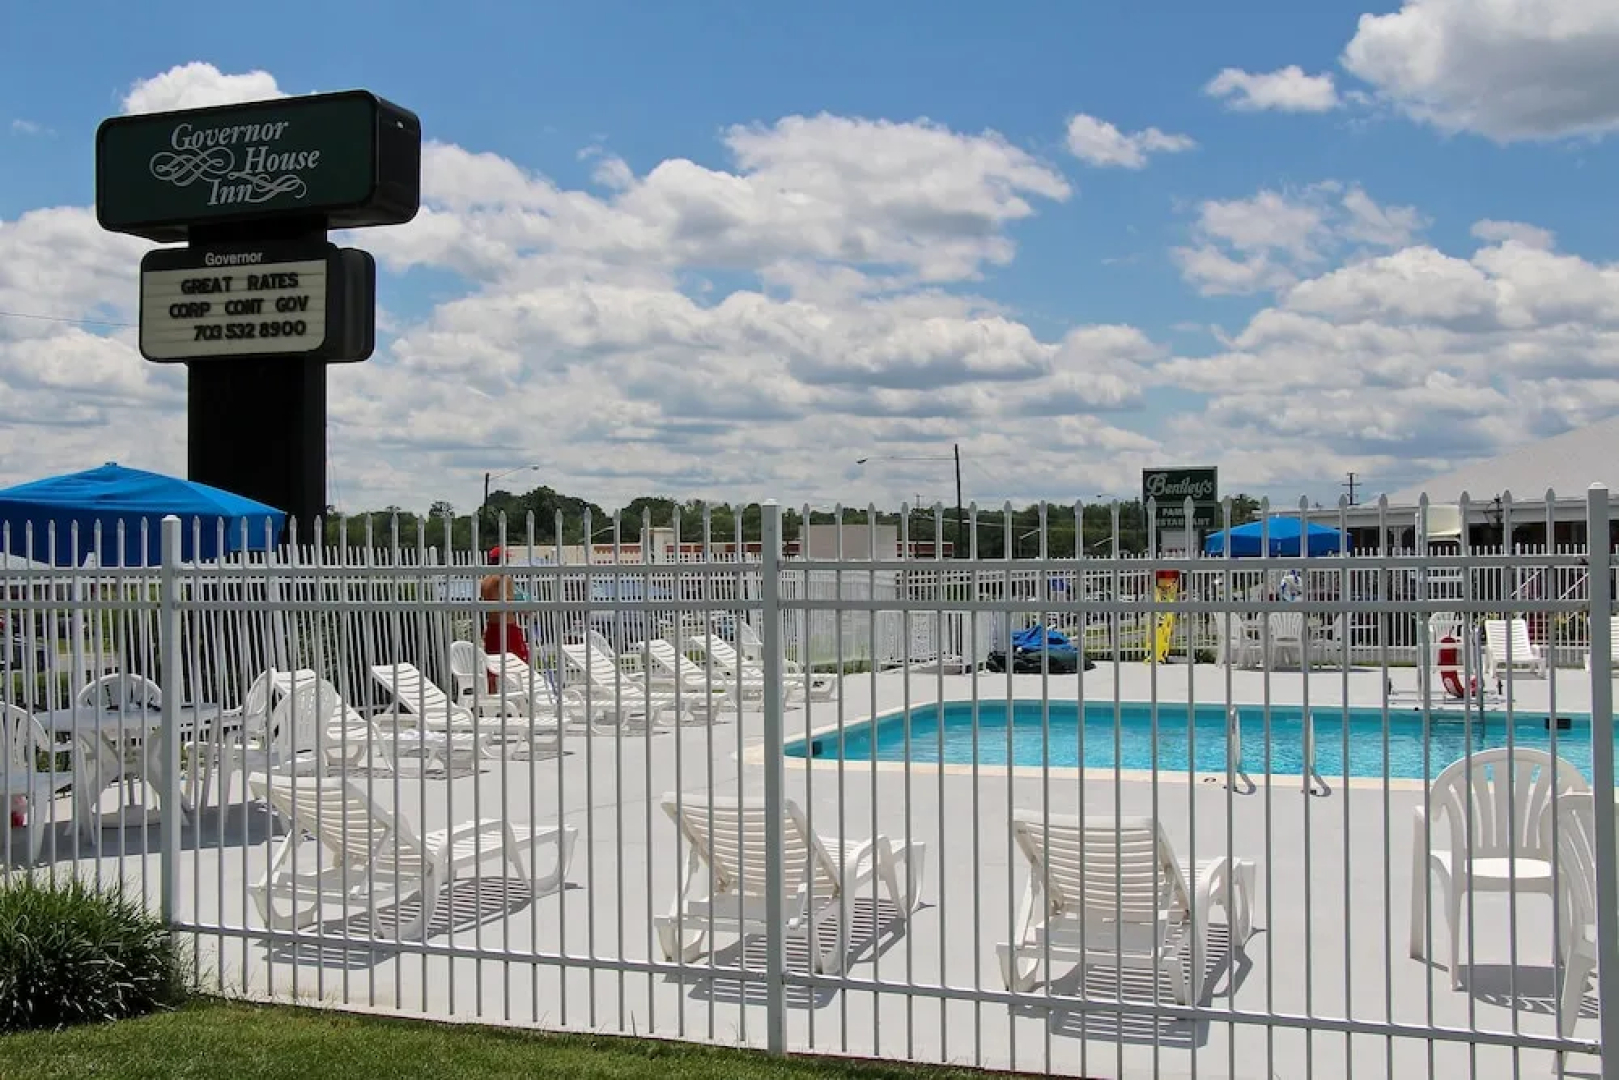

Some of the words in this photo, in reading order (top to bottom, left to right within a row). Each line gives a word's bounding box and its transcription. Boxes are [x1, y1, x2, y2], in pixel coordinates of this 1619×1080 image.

[171, 121, 289, 150] Governor
[243, 146, 320, 174] House
[207, 178, 252, 205] Inn
[205, 252, 263, 266] Governor
[181, 276, 233, 294] GREAT
[247, 272, 299, 291] RATES
[169, 302, 212, 319] CORP
[224, 298, 264, 315] CONT
[275, 295, 310, 313] GOV
[193, 324, 223, 341] 703
[224, 323, 255, 340] 532
[258, 320, 307, 338] 8900
[1146, 473, 1212, 498] Bentley's
